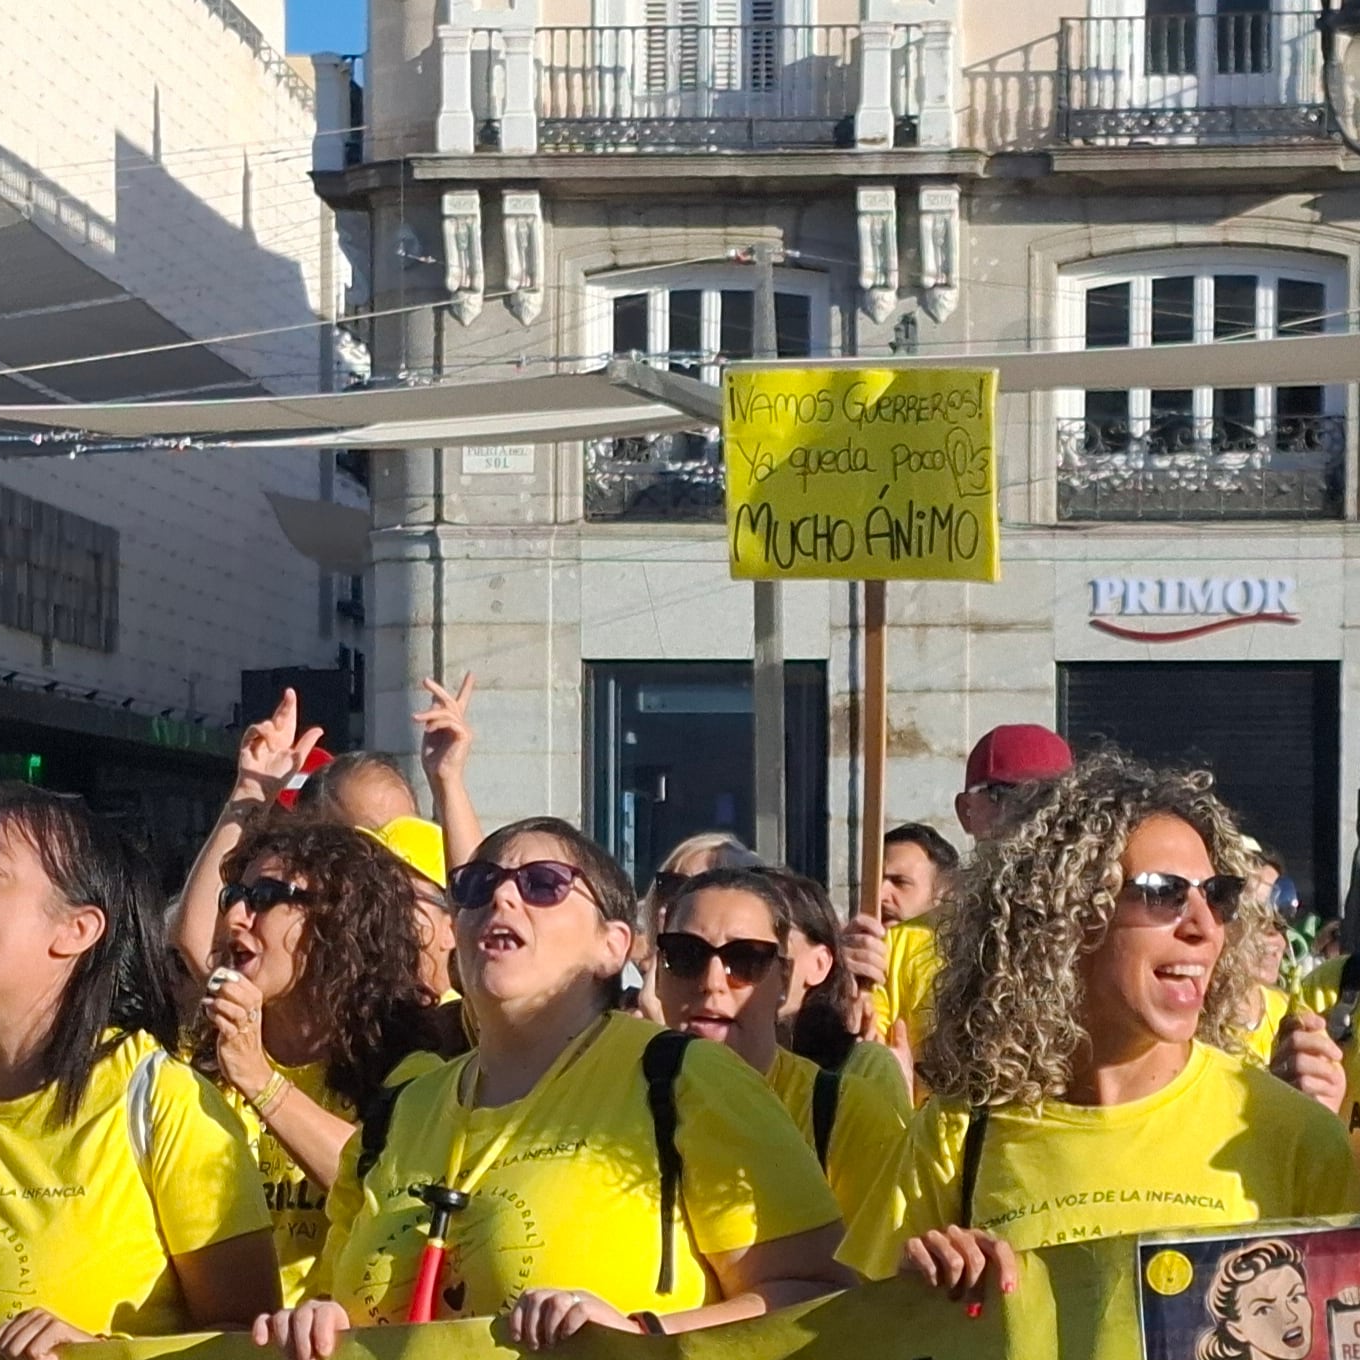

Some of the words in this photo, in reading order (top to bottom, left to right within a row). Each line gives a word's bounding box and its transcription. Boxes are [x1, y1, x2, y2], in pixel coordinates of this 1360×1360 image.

[485, 456, 510, 469] SOL
[789, 437, 878, 493] queda
[734, 502, 856, 569] MUCHO
[1089, 575, 1298, 616] PRIMOR
[22, 1185, 86, 1199] INFANCIA
[1030, 1201, 1051, 1215] LA
[1054, 1192, 1088, 1209] VOZ
[1092, 1190, 1115, 1204] DE
[1119, 1189, 1141, 1202] LA
[1145, 1189, 1225, 1211] INFANCIA
